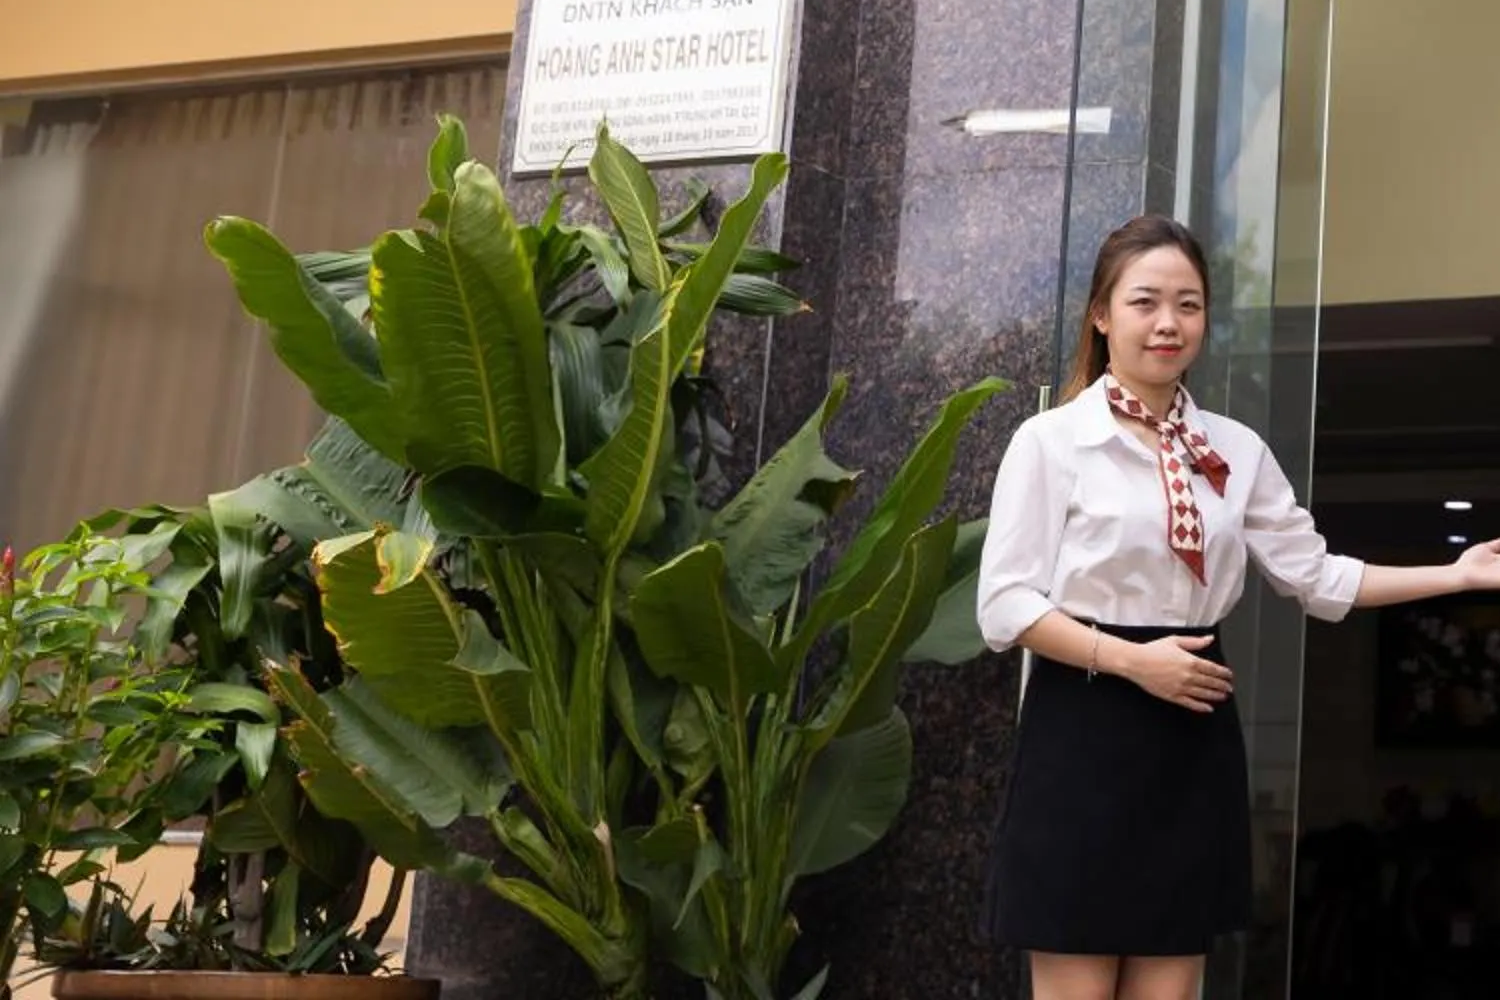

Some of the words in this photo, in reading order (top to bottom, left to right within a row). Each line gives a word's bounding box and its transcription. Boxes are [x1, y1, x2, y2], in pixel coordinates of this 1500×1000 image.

[536, 37, 602, 82] HOÀNG
[605, 38, 646, 76] ANH
[650, 33, 702, 73] STAR
[707, 28, 769, 66] HOTEL
